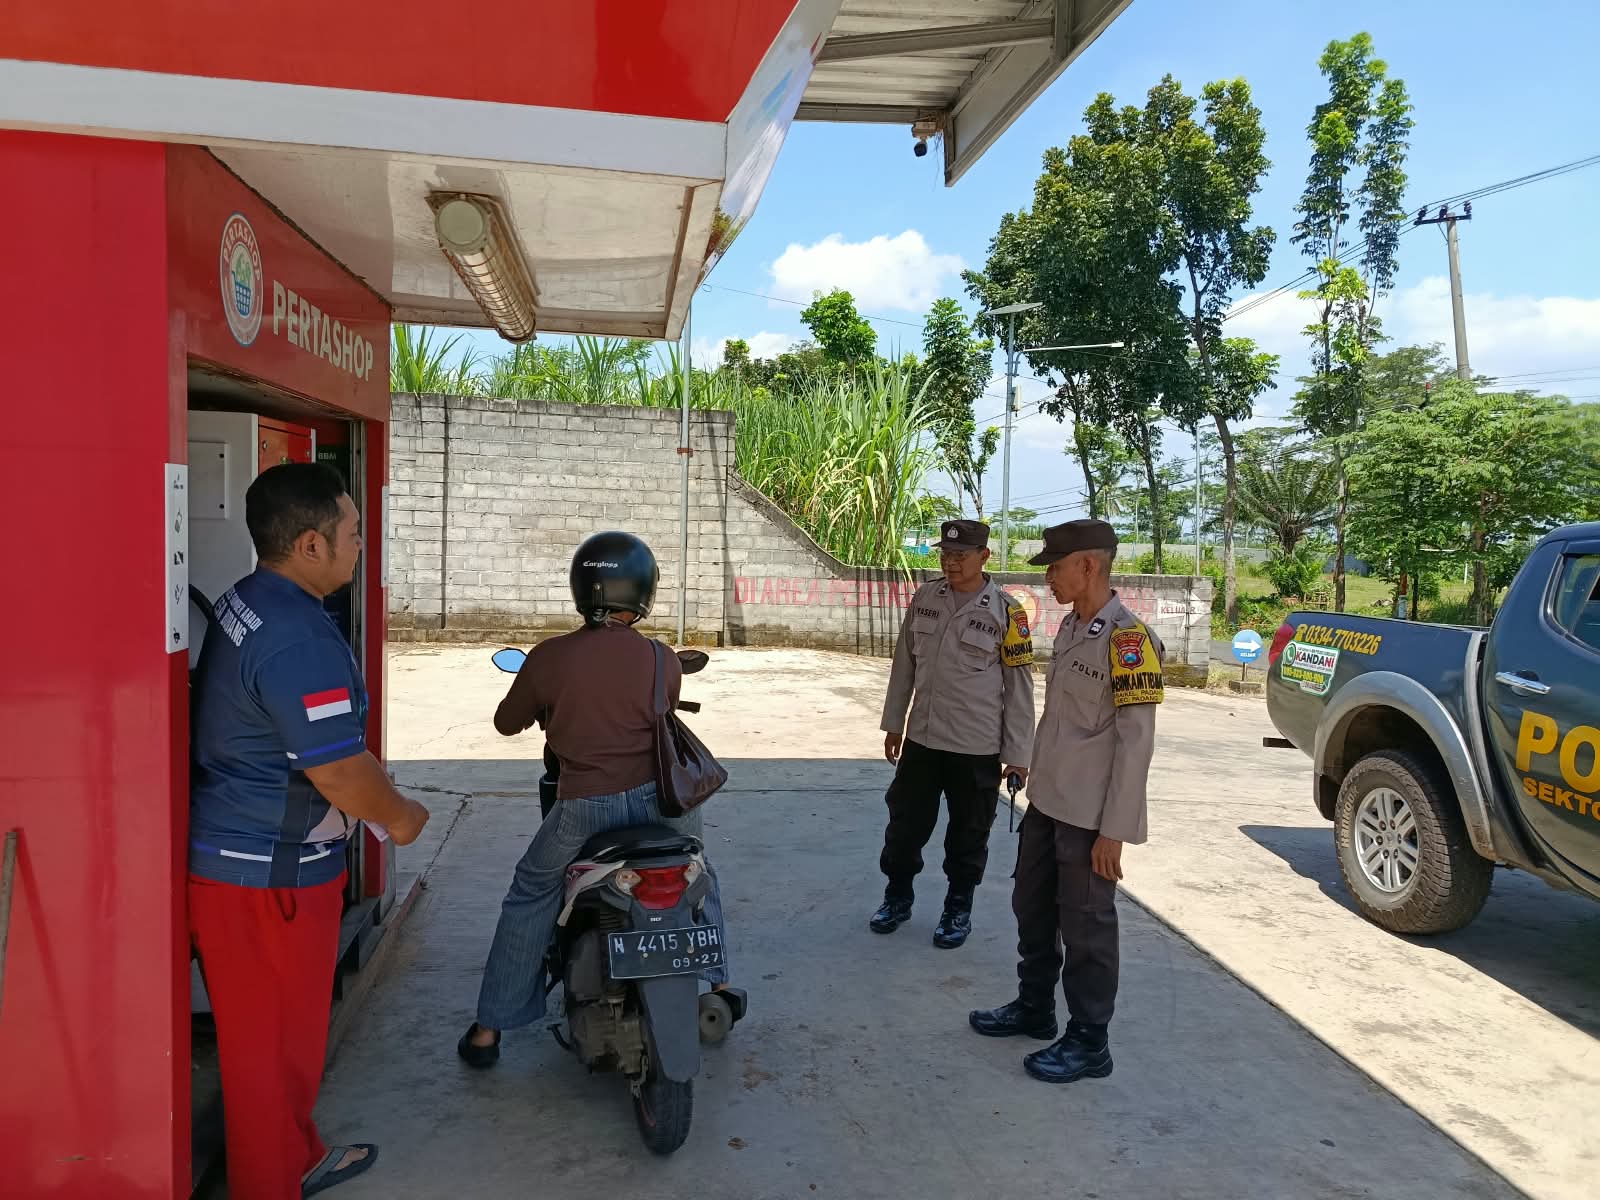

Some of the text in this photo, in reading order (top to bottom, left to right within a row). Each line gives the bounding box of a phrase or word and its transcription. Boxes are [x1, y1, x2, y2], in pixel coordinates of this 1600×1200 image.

[223, 221, 261, 281] PERTASHOP
[273, 279, 374, 382] PERTASHOP
[240, 607, 263, 632] ABADI
[969, 619, 998, 636] POLRI
[1305, 625, 1383, 656] 0334-7703226
[1072, 660, 1105, 681] POLRI
[1295, 650, 1335, 668] KANDANI
[1516, 709, 1600, 793] PO
[614, 928, 718, 953] N 4415 YBH
